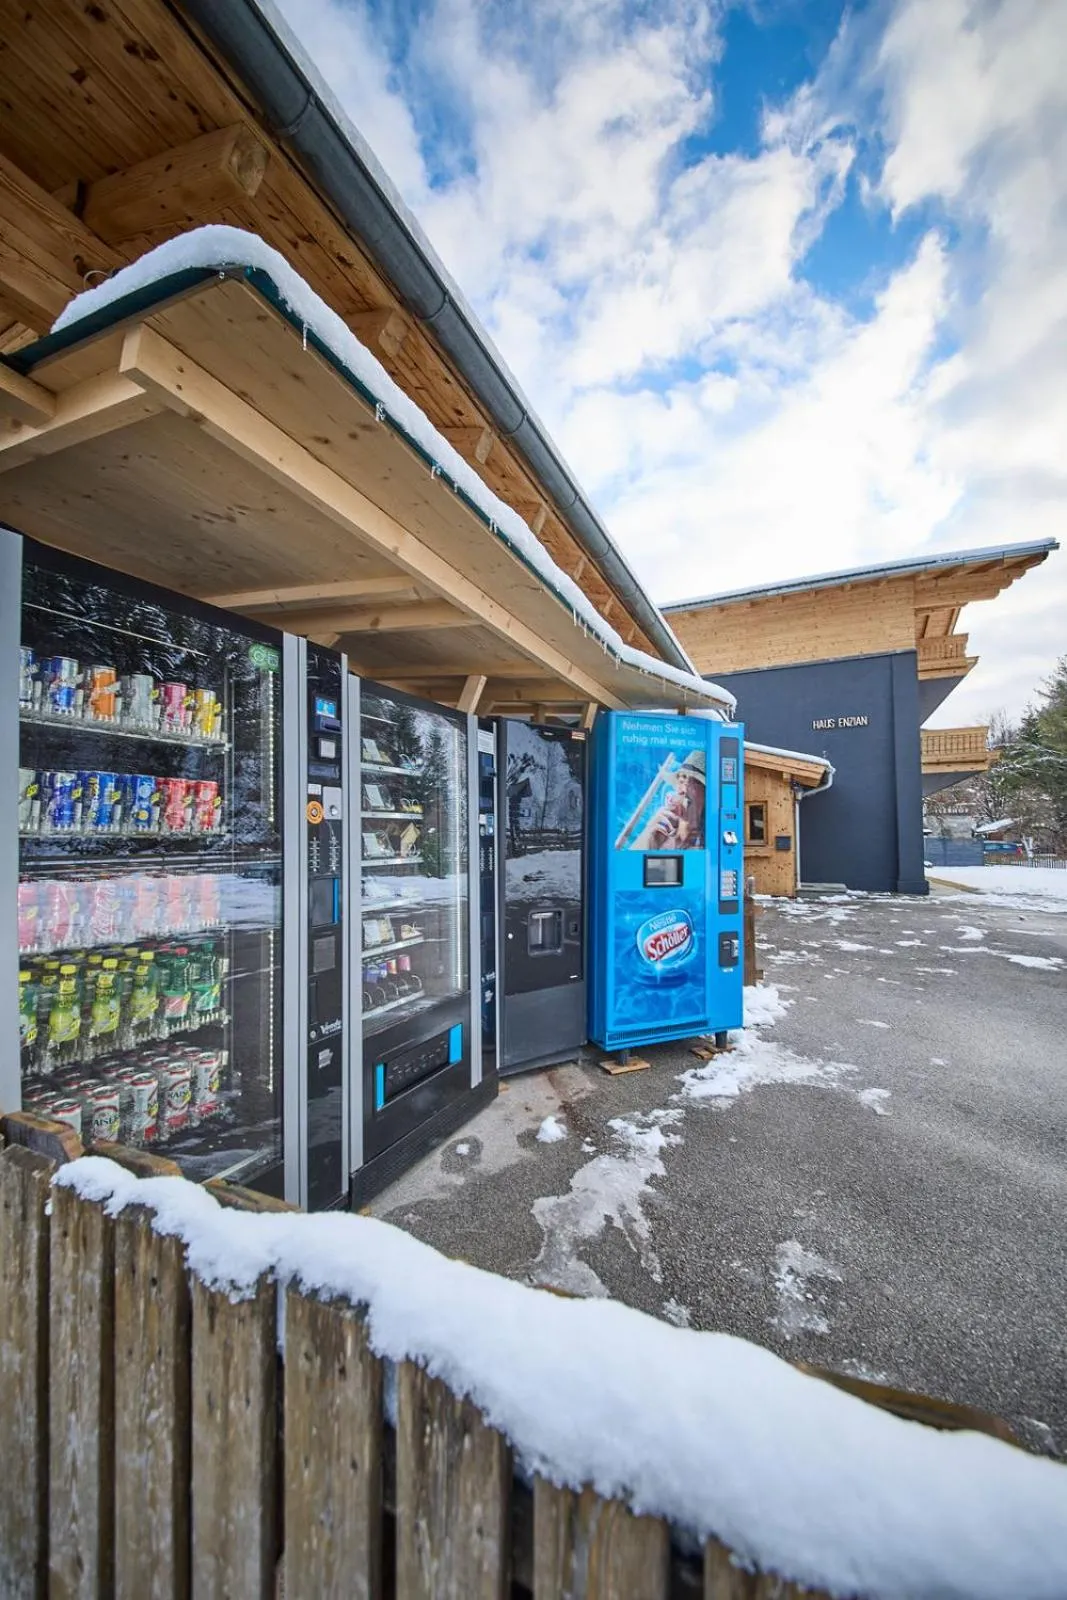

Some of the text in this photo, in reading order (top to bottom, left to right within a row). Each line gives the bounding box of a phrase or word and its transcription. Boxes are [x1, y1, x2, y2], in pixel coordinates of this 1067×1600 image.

[622, 721, 663, 733] Nehmen
[664, 723, 679, 734] Sie
[812, 716, 868, 730] HAUS ENZIAN
[622, 733, 649, 746] ruhig
[650, 735, 668, 745] mal
[669, 738, 687, 747] was
[646, 926, 689, 961] Schöller
